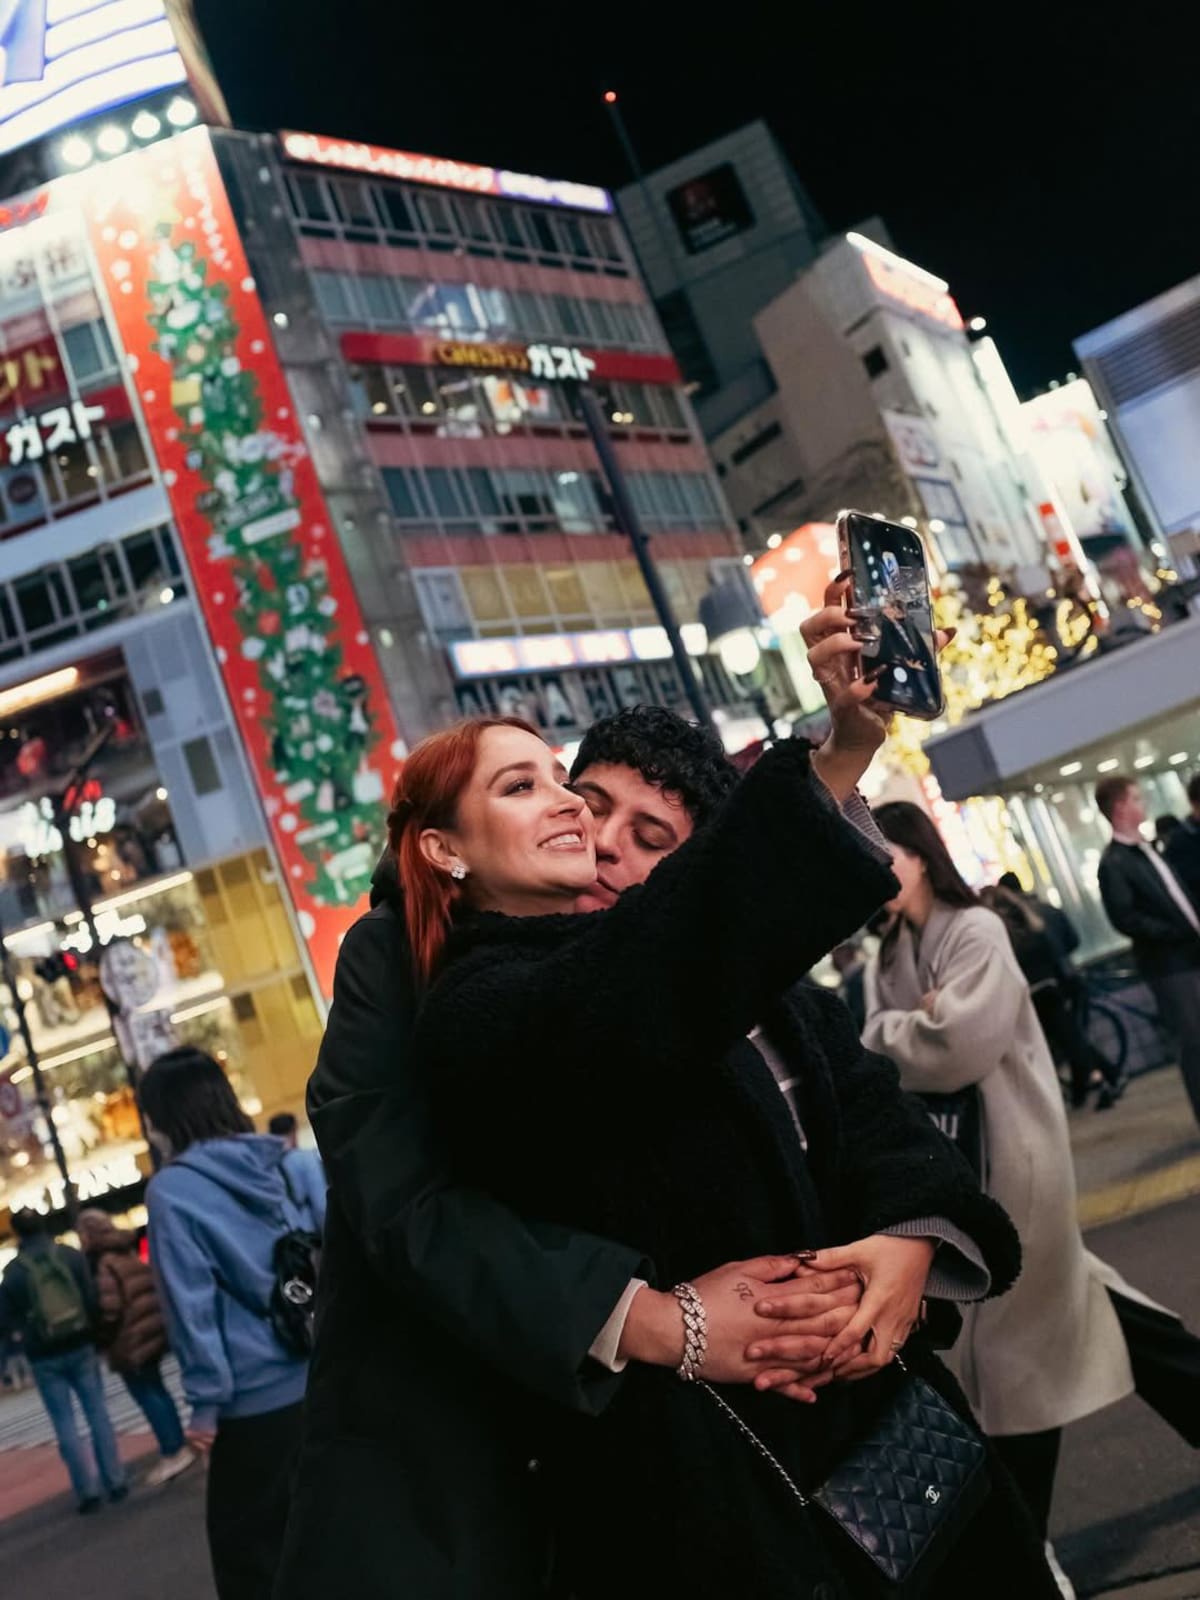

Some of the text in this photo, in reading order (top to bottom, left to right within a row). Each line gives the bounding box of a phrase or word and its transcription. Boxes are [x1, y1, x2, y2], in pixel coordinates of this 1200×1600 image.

[527, 344, 596, 381] ガスト
[6, 400, 105, 465] ガスト
